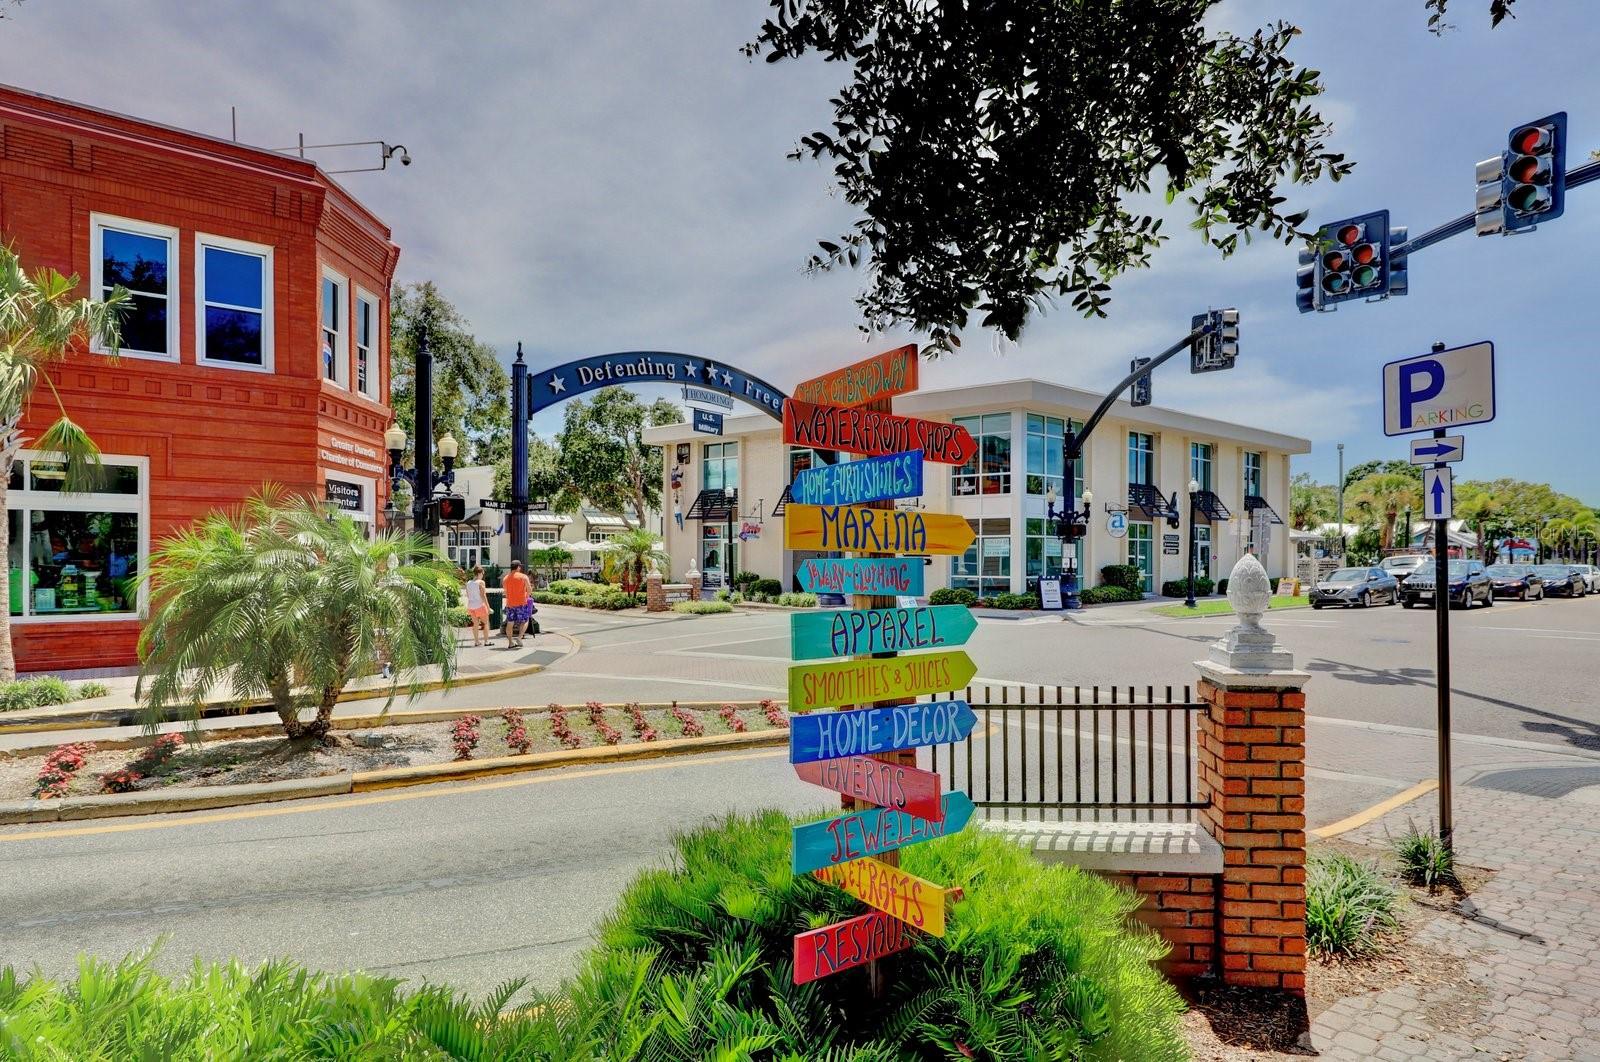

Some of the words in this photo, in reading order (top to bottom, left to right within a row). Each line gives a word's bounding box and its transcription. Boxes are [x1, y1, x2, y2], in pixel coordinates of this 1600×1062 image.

[578, 357, 675, 385] Defending
[745, 379, 785, 413] Free
[689, 389, 730, 406] HONORING
[789, 402, 910, 453] WATERFRONT
[915, 418, 962, 460] SHOPS
[328, 484, 359, 497] Visitors
[802, 469, 831, 504] HOME
[832, 455, 913, 505] FURNISHINGS
[831, 607, 944, 656] APPAREL
[802, 660, 890, 705] SMOOTHIES
[904, 656, 950, 692] JUICES
[817, 709, 883, 759] HOME
[892, 701, 962, 749] DECOR
[857, 858, 925, 927] CRAFTS
